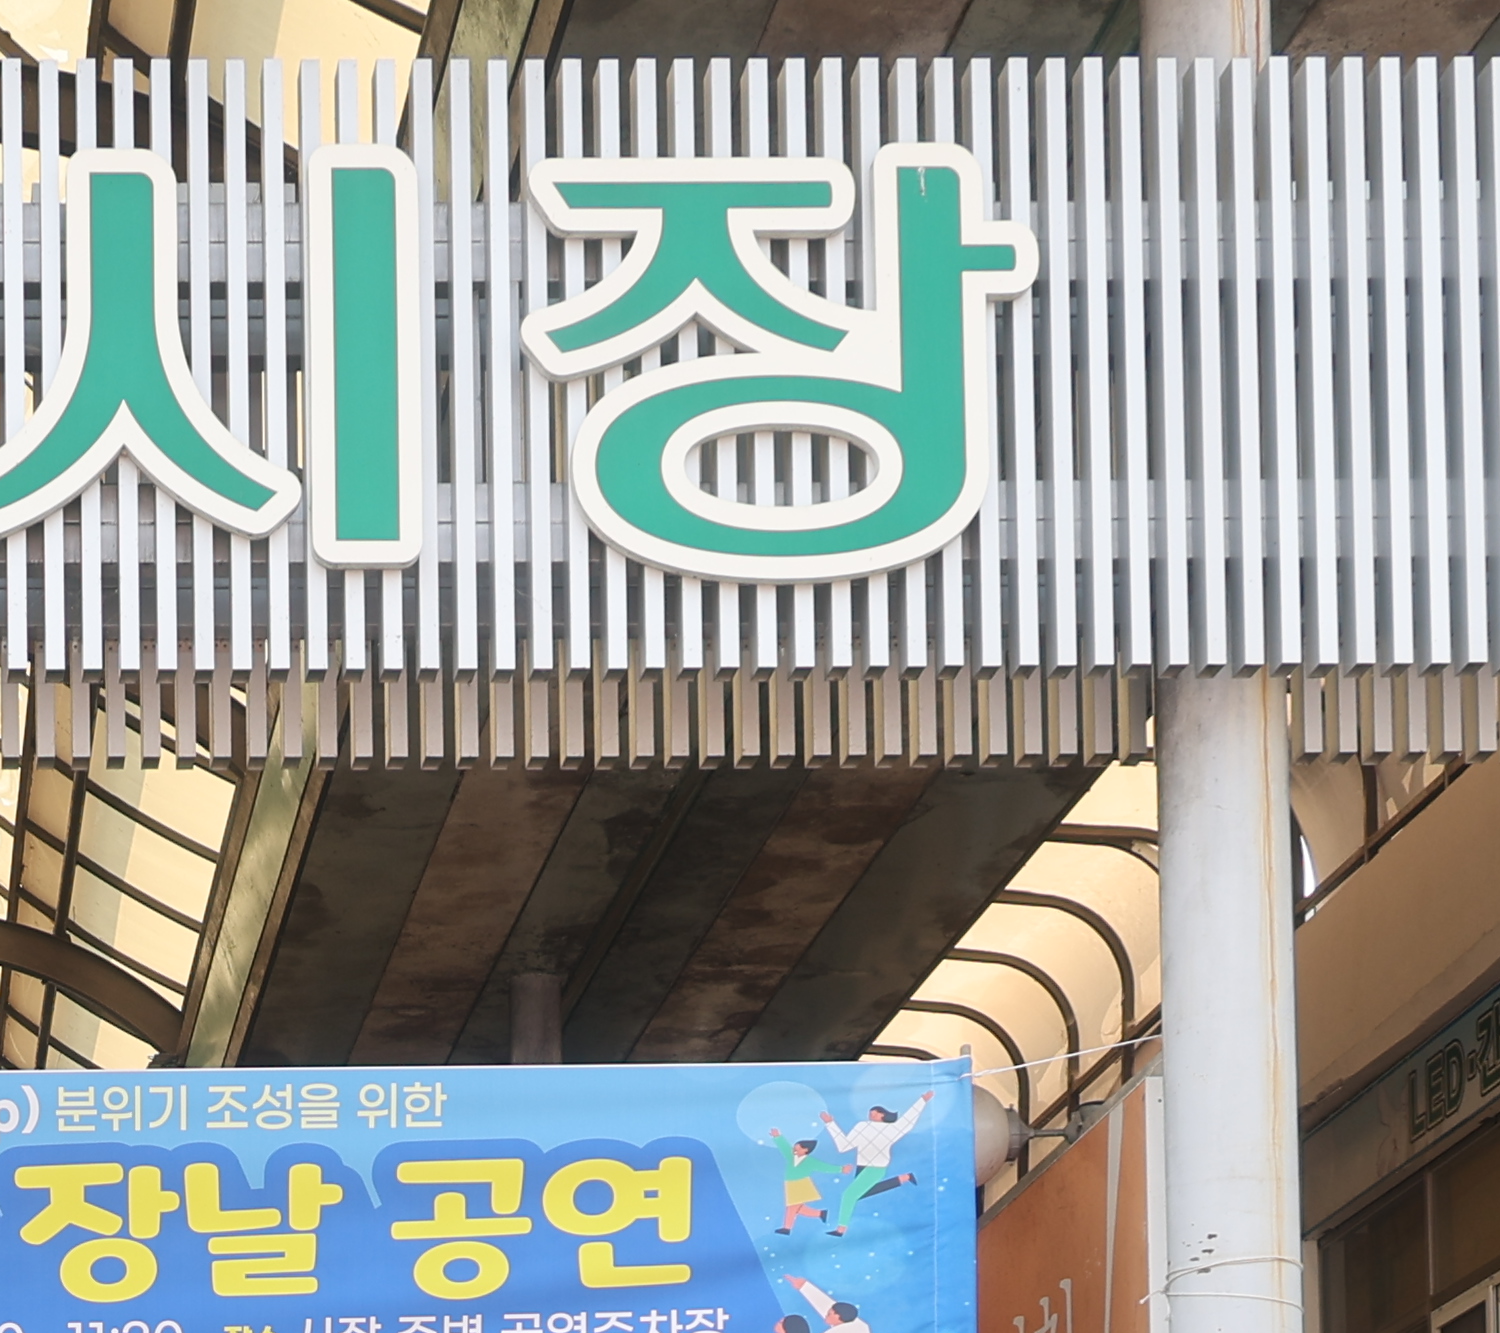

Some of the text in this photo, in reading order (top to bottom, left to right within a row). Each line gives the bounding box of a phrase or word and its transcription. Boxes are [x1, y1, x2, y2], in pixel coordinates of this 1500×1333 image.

[55, 1085, 189, 1132] 분위기
[206, 1082, 341, 1131] 조성을
[356, 1080, 448, 1129] 위한
[14, 1161, 343, 1303] 장날
[391, 1156, 692, 1300] 공연
